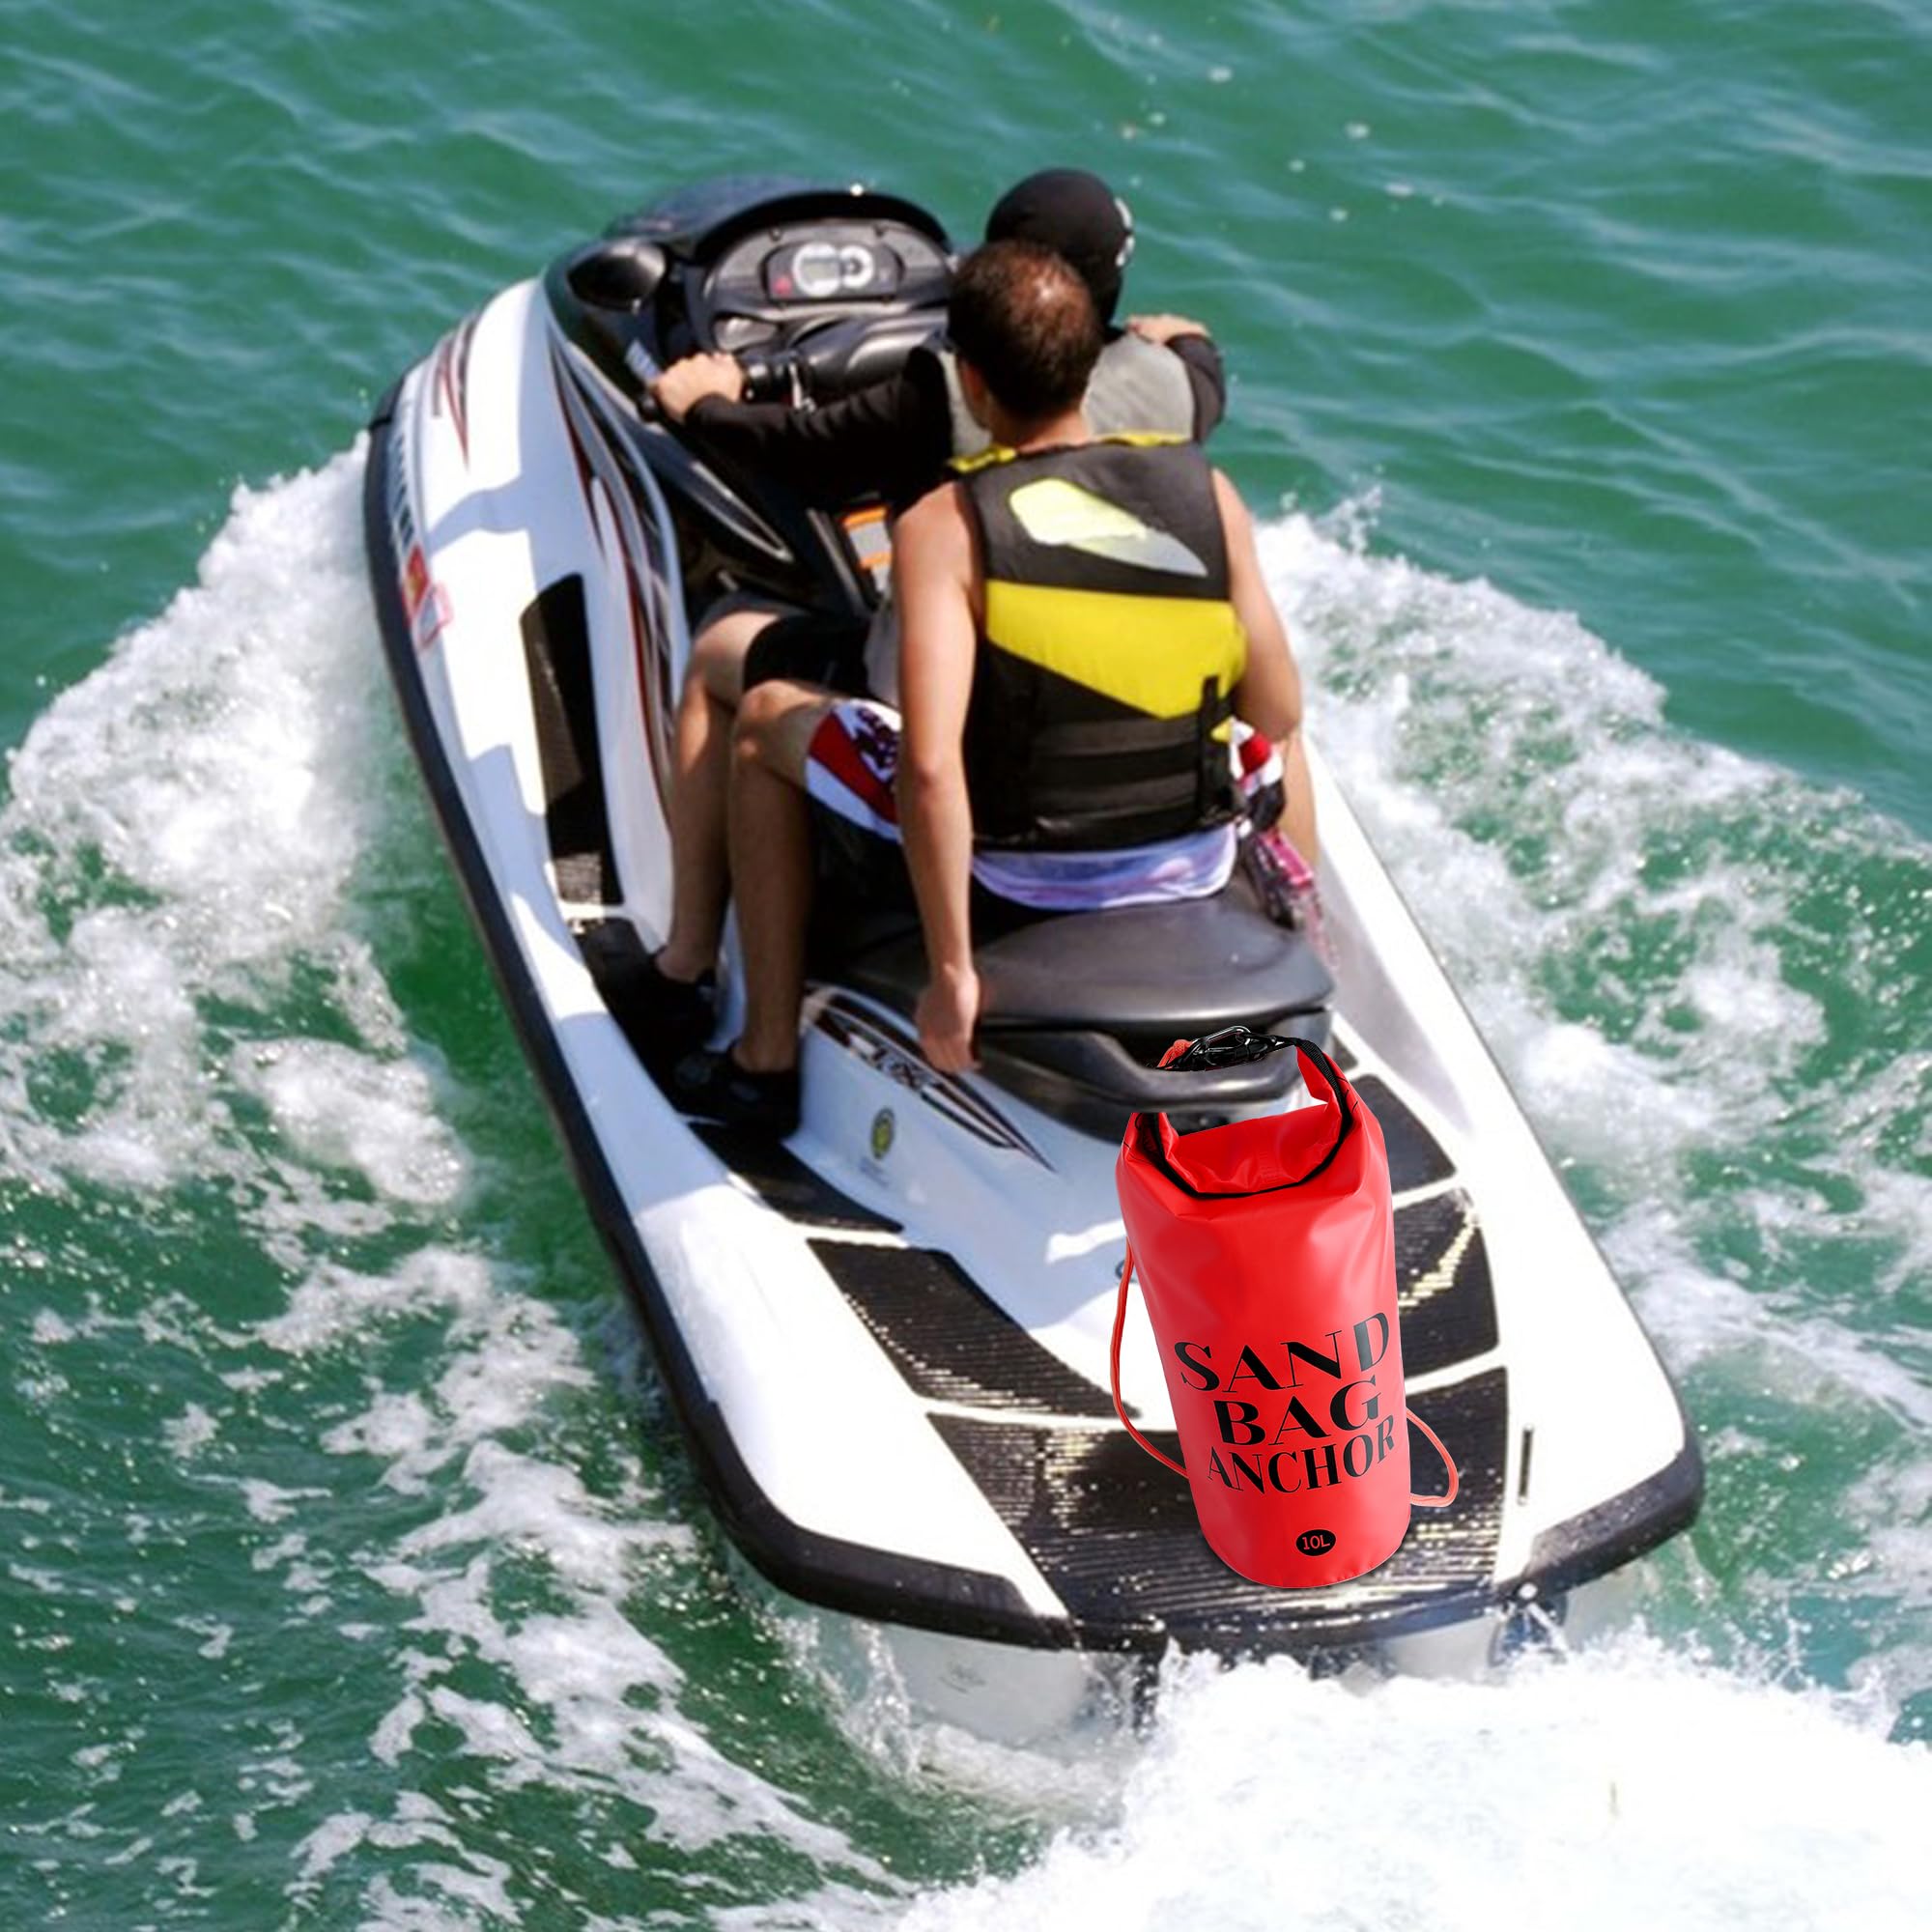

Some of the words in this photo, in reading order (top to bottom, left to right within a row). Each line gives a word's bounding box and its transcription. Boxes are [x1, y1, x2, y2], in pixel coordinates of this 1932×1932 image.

[1174, 1312, 1389, 1393] SAND
[1213, 1375, 1381, 1445] BAG
[1208, 1414, 1395, 1494] ANCHOR
[1301, 1534, 1331, 1551] 10L
